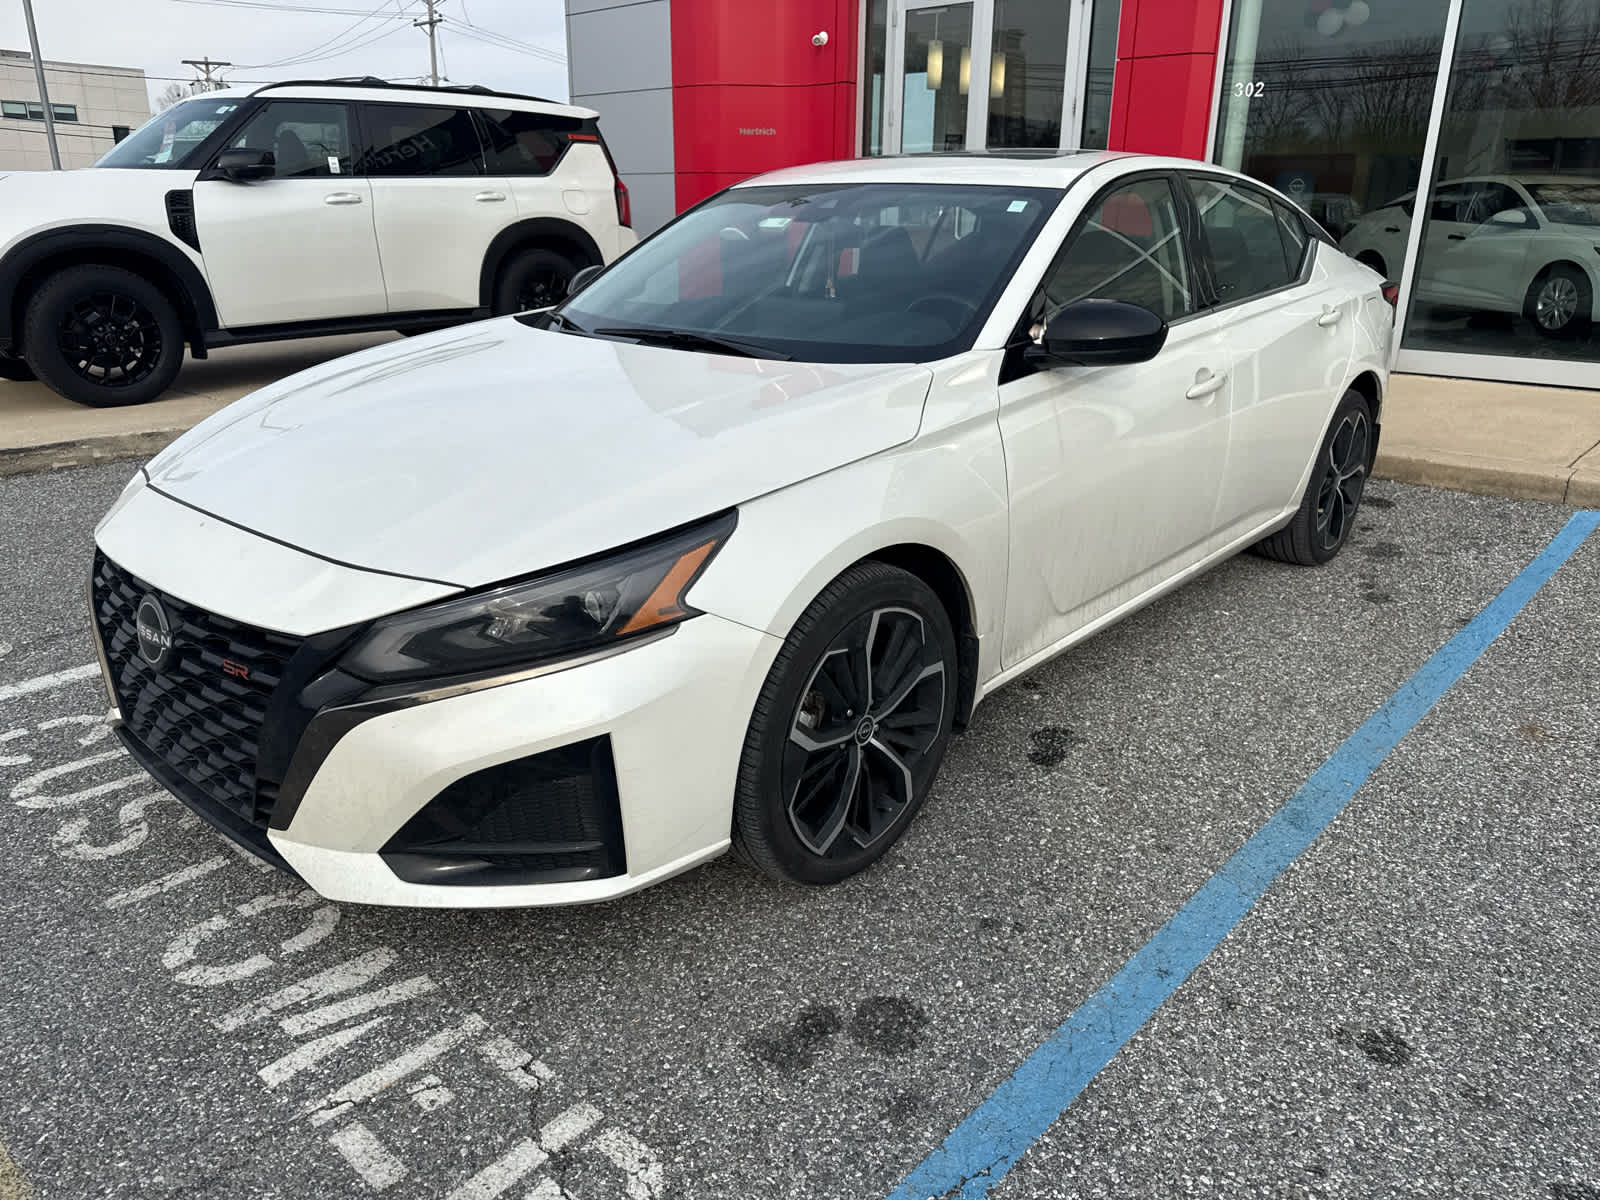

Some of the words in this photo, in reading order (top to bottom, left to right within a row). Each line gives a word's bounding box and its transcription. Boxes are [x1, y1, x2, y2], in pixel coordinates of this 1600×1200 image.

[1233, 81, 1265, 98] 302
[738, 127, 777, 137] Hertrich
[138, 623, 171, 648] SSAN
[222, 658, 249, 681] SR
